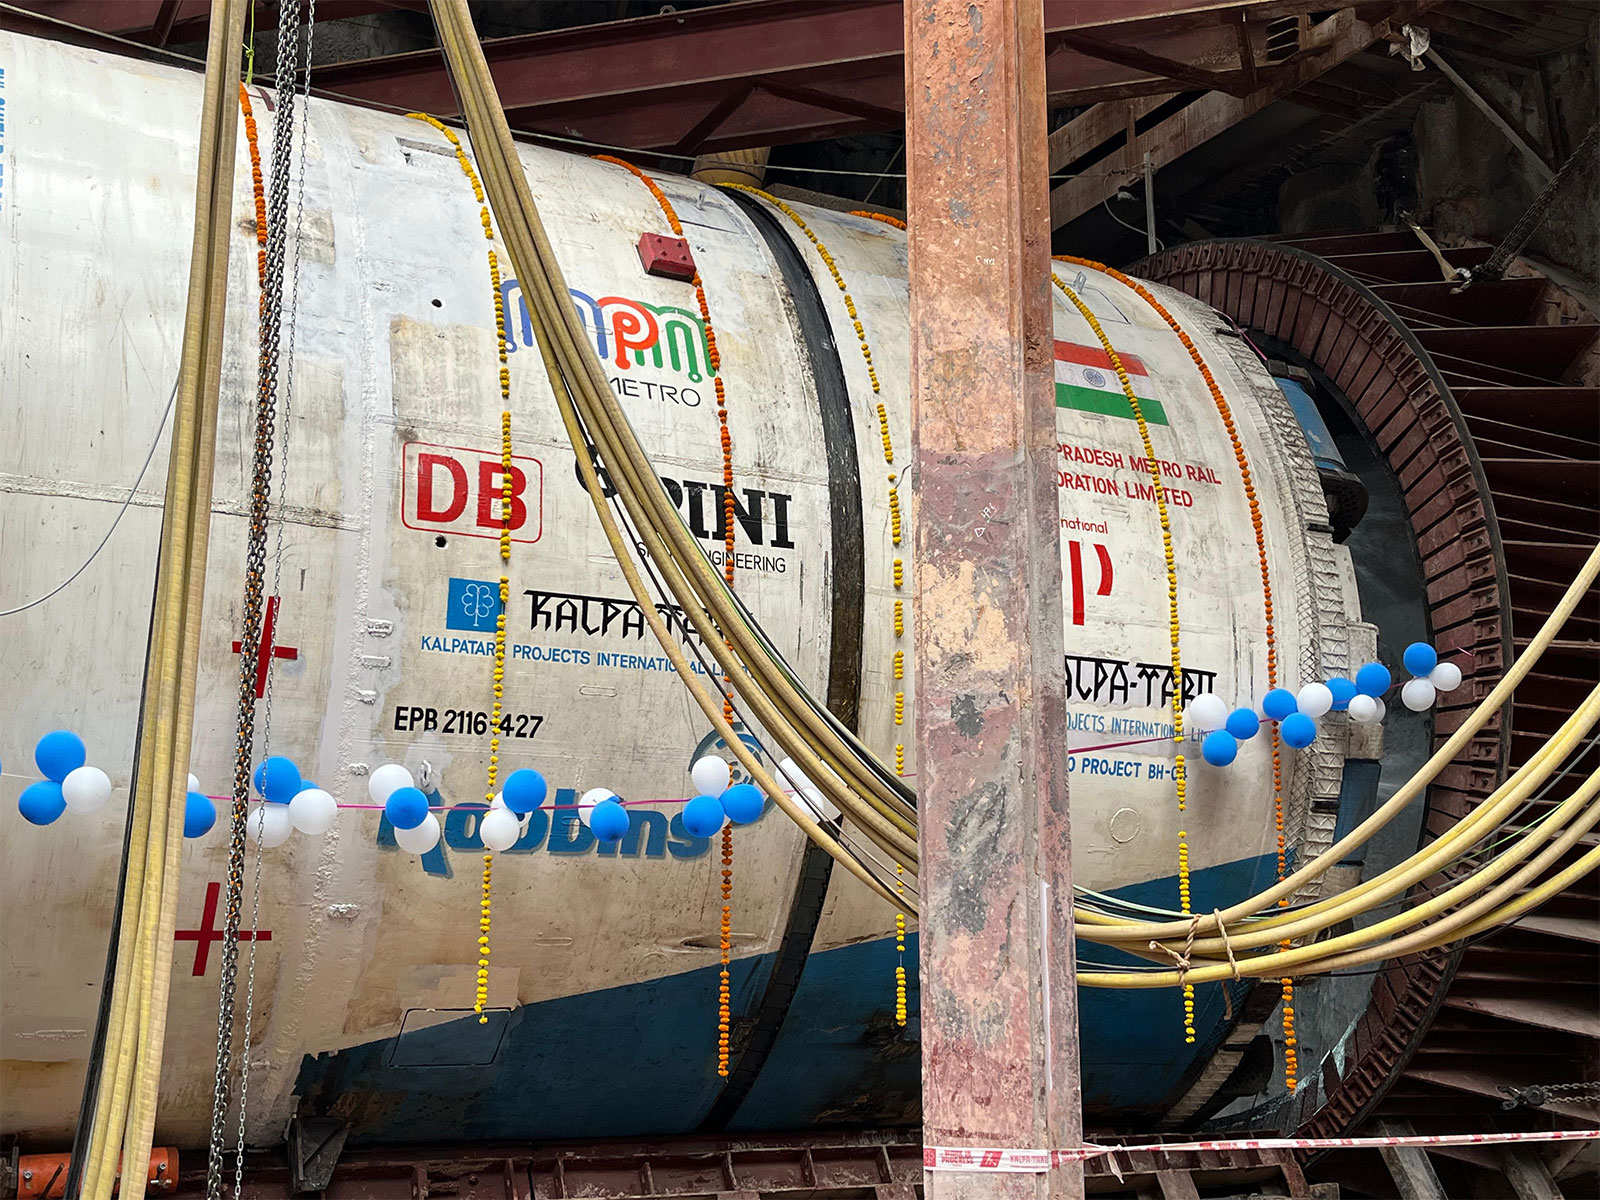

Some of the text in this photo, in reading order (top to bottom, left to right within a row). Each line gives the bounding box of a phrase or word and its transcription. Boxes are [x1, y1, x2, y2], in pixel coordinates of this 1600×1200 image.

[1129, 455, 1182, 479] METRO
[1185, 465, 1222, 485] RAIL
[417, 452, 527, 531] DB
[1061, 517, 1108, 534] national
[421, 636, 505, 657] KALPATAR
[513, 645, 590, 665] PROJECTS
[394, 706, 544, 739] EPB 2116-427
[1082, 757, 1142, 778] PROJECT
